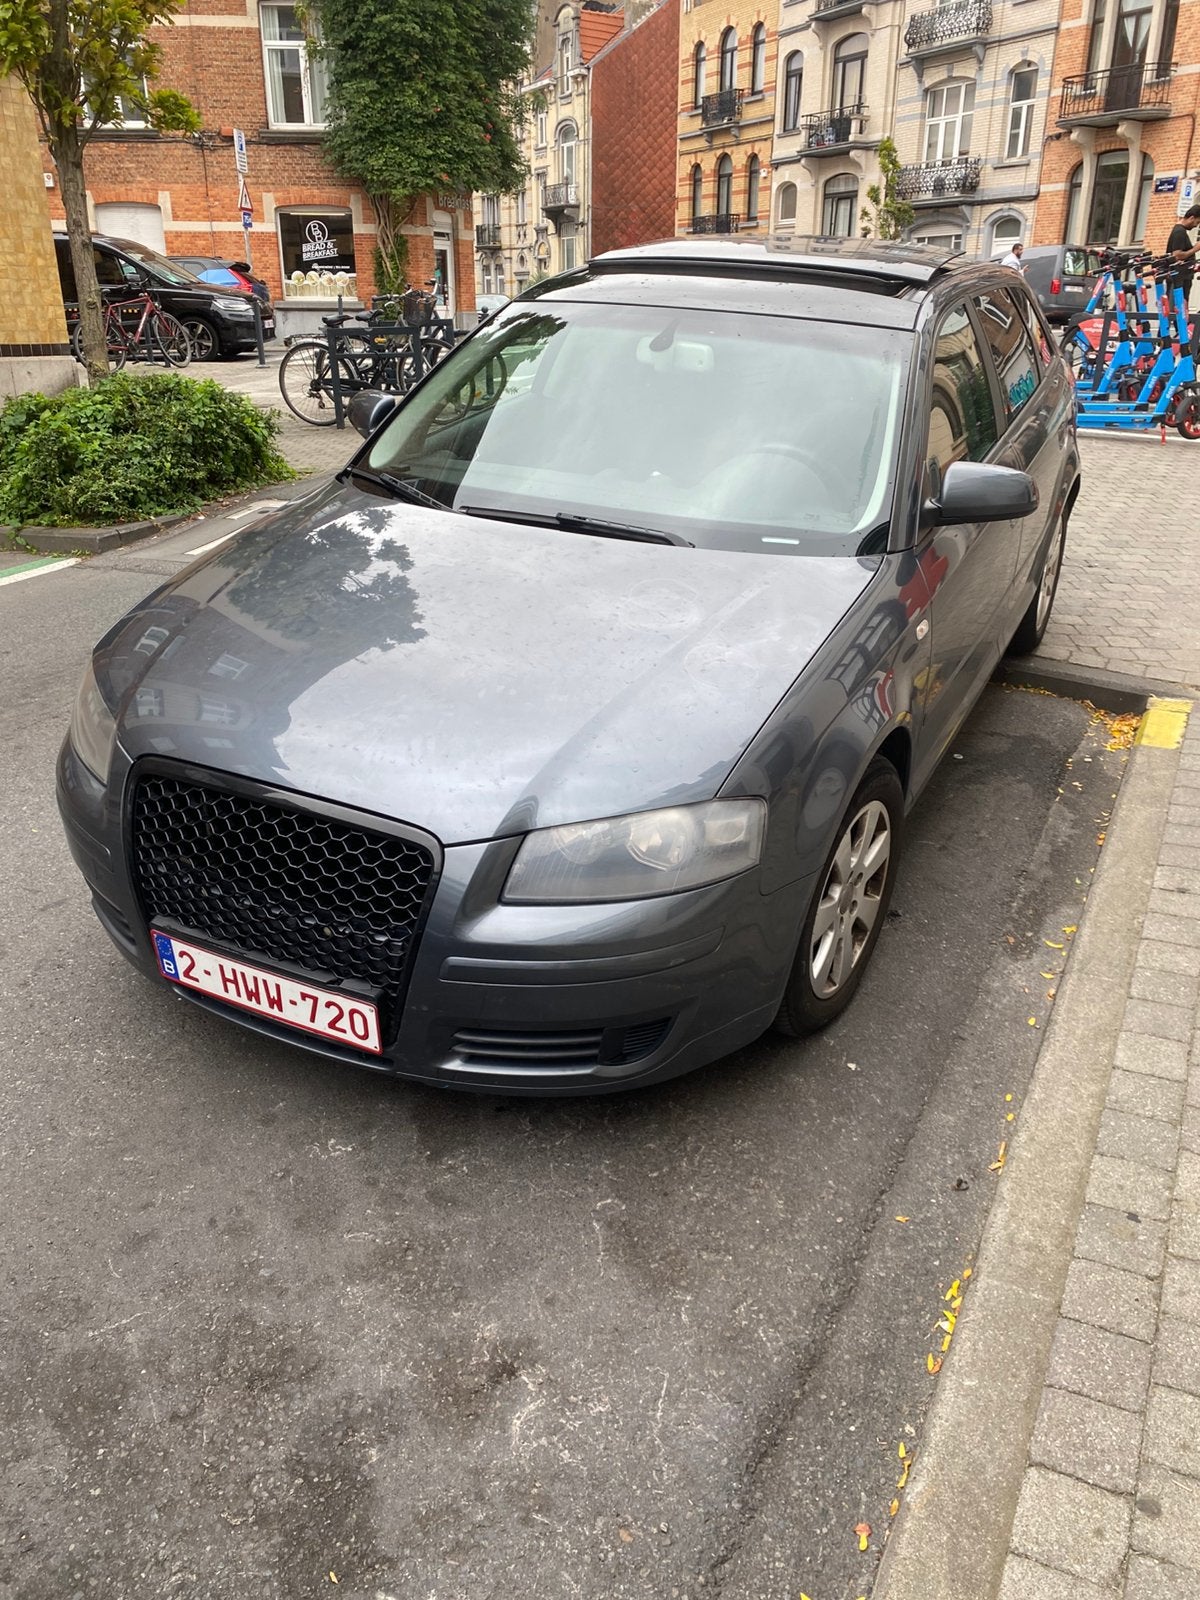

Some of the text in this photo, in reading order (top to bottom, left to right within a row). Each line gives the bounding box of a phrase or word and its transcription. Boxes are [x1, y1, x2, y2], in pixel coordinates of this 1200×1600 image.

[302, 239, 334, 253] BREAD &
[302, 248, 338, 260] BREAKFAST
[163, 958, 175, 975] B
[178, 950, 370, 1041] 2-HWW-720
